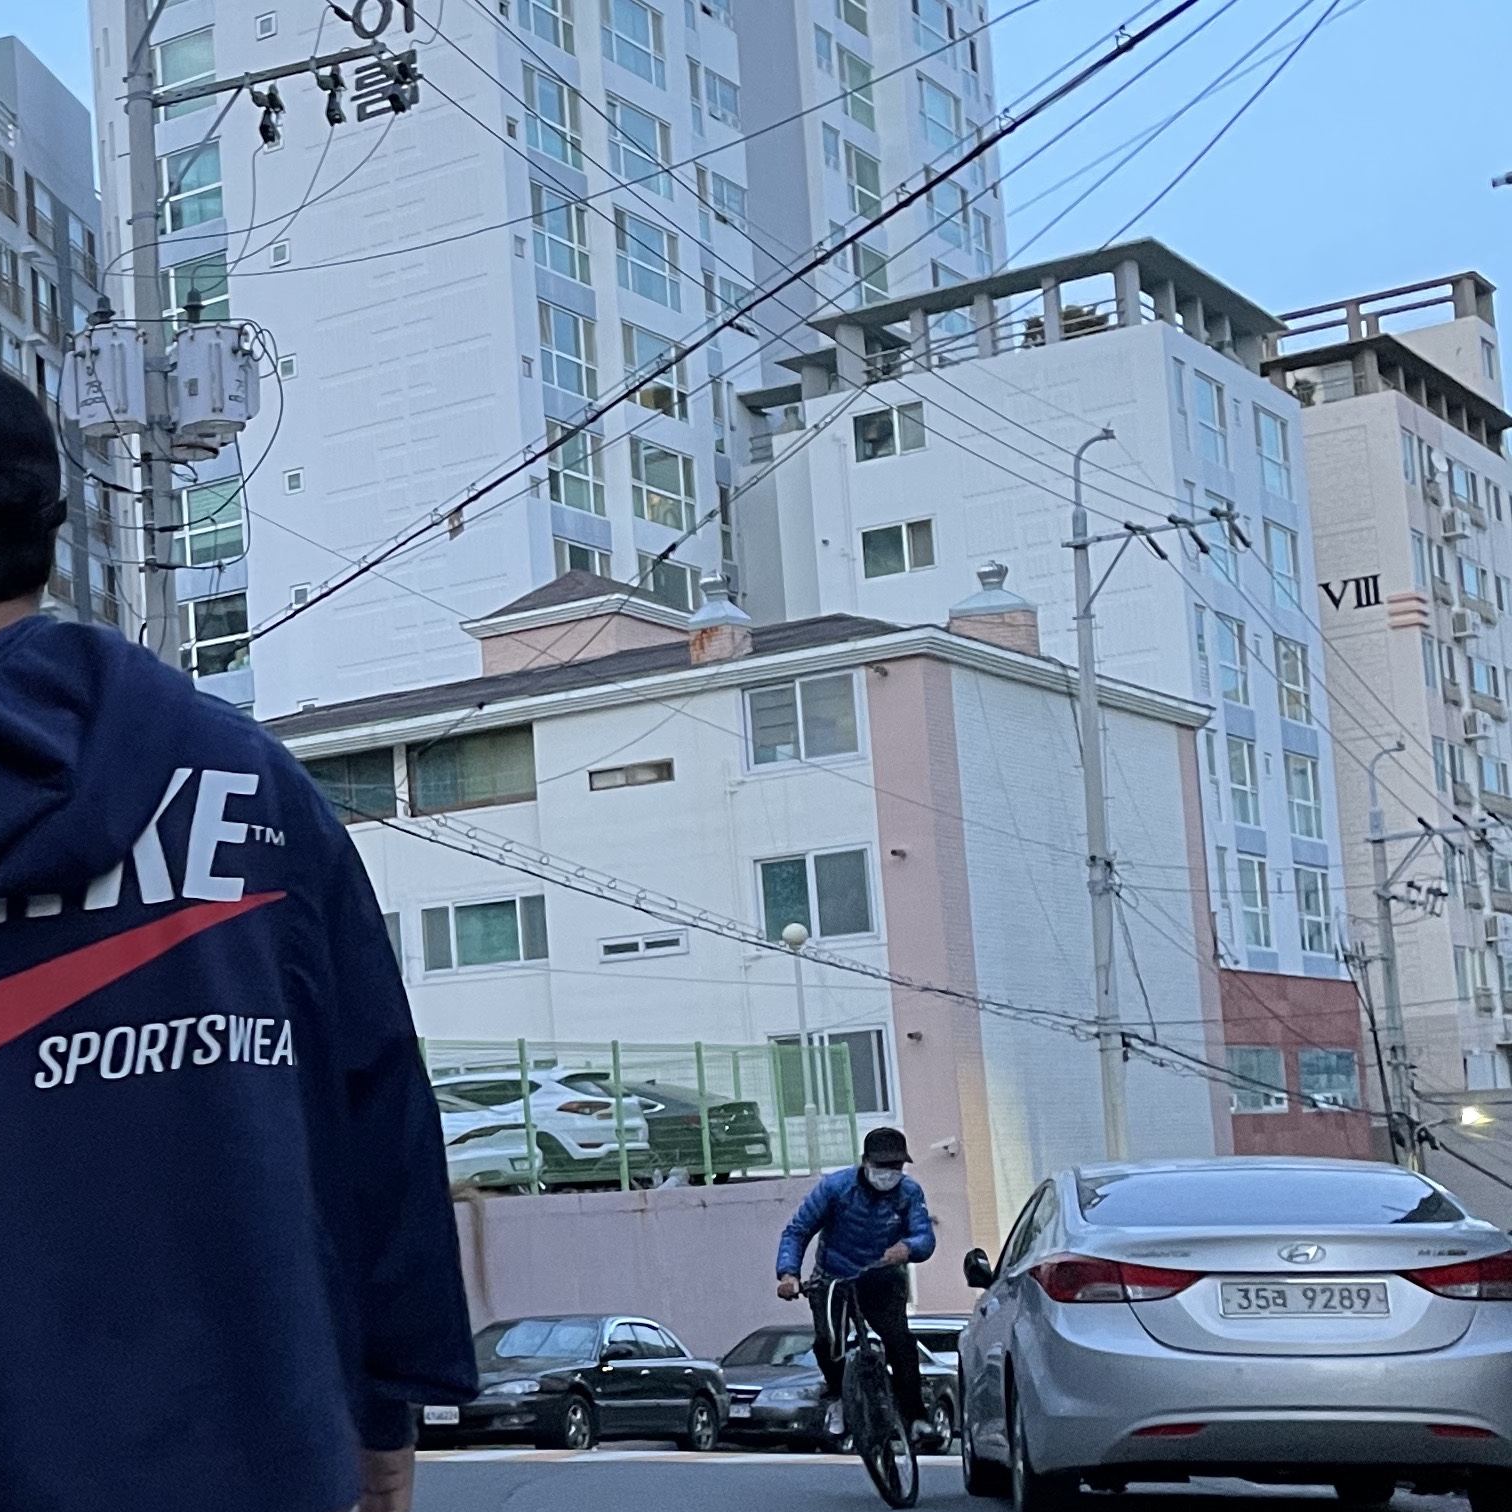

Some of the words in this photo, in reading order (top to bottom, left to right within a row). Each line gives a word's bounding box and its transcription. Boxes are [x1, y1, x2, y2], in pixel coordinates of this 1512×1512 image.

[1318, 573, 1384, 611] VIII
[35, 1014, 298, 1089] SPORTSWEA
[1302, 1287, 1371, 1310] 9289
